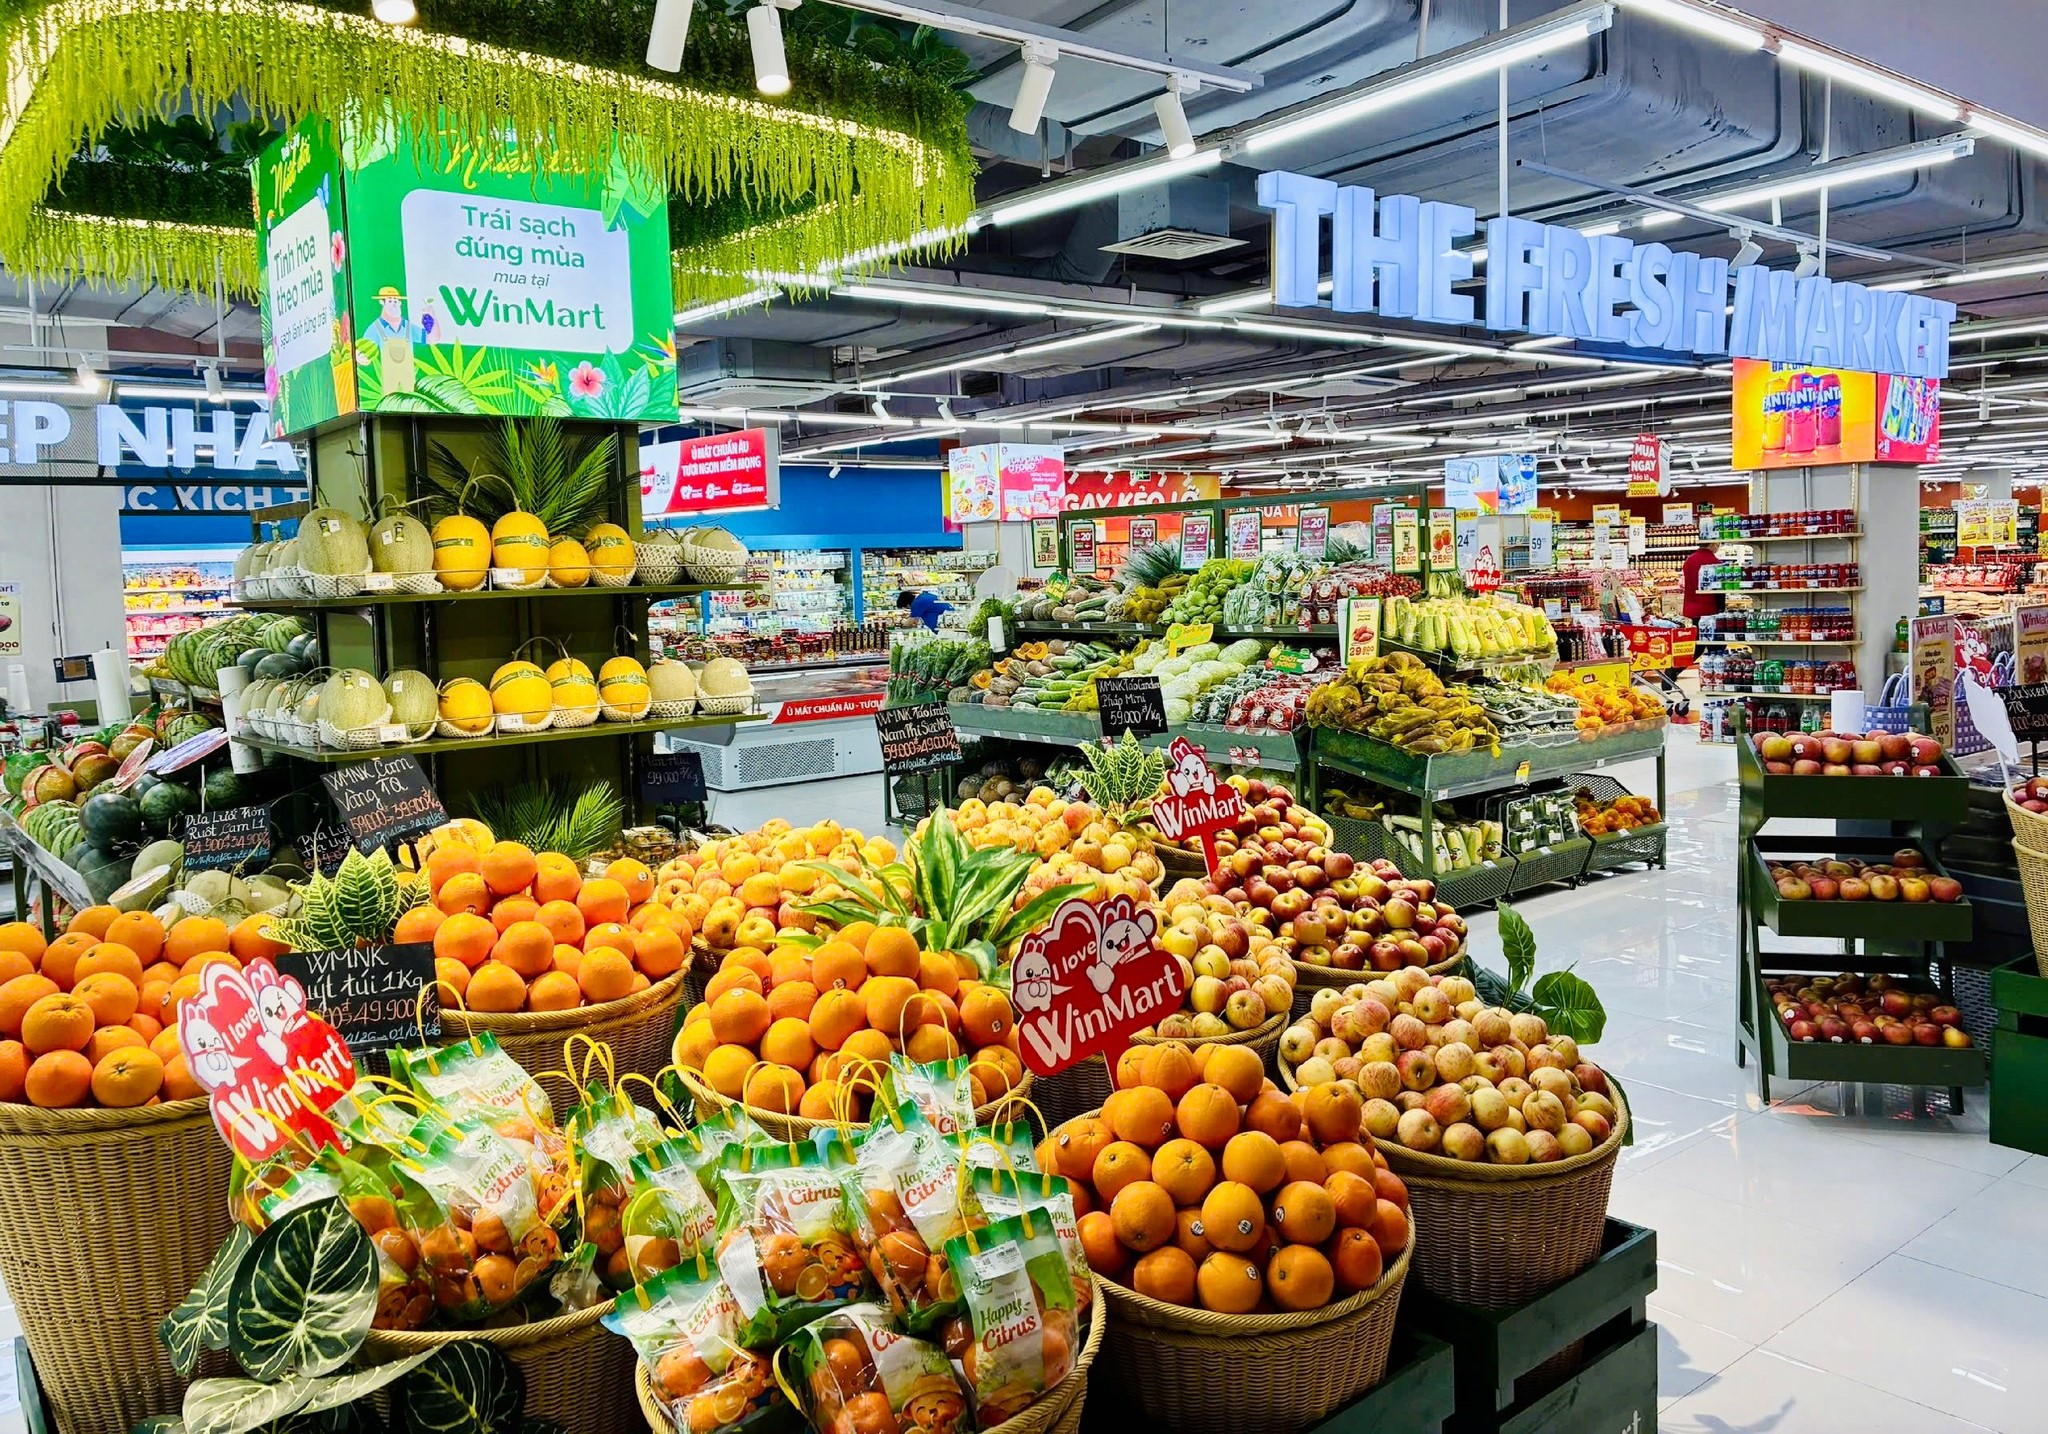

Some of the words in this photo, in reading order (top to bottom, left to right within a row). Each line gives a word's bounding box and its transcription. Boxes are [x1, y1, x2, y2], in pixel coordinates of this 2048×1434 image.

[461, 205, 511, 231] Trái
[519, 216, 576, 240] sạch
[296, 234, 316, 275] hoa
[455, 236, 523, 265] đúng
[531, 246, 585, 268] mùa
[493, 271, 527, 285] mua
[531, 273, 550, 288] tại
[1258, 170, 1475, 323] THE
[1486, 215, 1728, 355] FRESH
[1729, 264, 1957, 380] MARKET
[276, 286, 299, 318] theo
[300, 265, 324, 304] mùa
[438, 284, 607, 331] WinMart
[0, 401, 70, 464] P
[97, 400, 300, 471] NHÀ
[691, 444, 697, 460] Ủ
[697, 443, 712, 458] MÁT
[1635, 442, 1656, 458] MUA
[699, 461, 720, 475] NGON
[1631, 460, 1657, 472] NGAY
[1457, 533, 1469, 548] 24
[1531, 538, 1542, 550] 59
[1465, 570, 1504, 587] WinMart
[1916, 619, 1949, 638] WinMart
[2020, 611, 2048, 629] WinMar
[786, 706, 793, 716] Ủ
[794, 706, 812, 716] MÁT
[813, 702, 842, 714] CHUẨN
[843, 701, 855, 711] ÂU
[1125, 692, 1146, 704] Mini
[879, 728, 906, 744] Nam
[905, 721, 922, 739] Phi
[375, 756, 414, 779] Cam
[335, 788, 381, 811] Vàng
[375, 776, 408, 795] TQ
[239, 806, 266, 819] Tròn
[1153, 793, 1247, 839] WinMart
[219, 822, 250, 836] Cam
[252, 817, 266, 829] L1
[305, 945, 389, 974] WMNK
[1052, 963, 1061, 982] I
[1063, 941, 1098, 975] love
[340, 968, 378, 997] túi
[1021, 963, 1182, 1068] WinMart
[221, 1032, 235, 1052] I
[232, 1009, 259, 1044] love
[216, 1034, 353, 1153] WinMart
[472, 1153, 514, 1196] Happy
[484, 1162, 528, 1206] Citrus
[787, 1185, 842, 1206] Citrus
[1049, 1211, 1069, 1224] ppy
[1056, 1227, 1077, 1239] rus
[980, 1298, 1023, 1331] Happy
[982, 1314, 1037, 1353] Citrus
